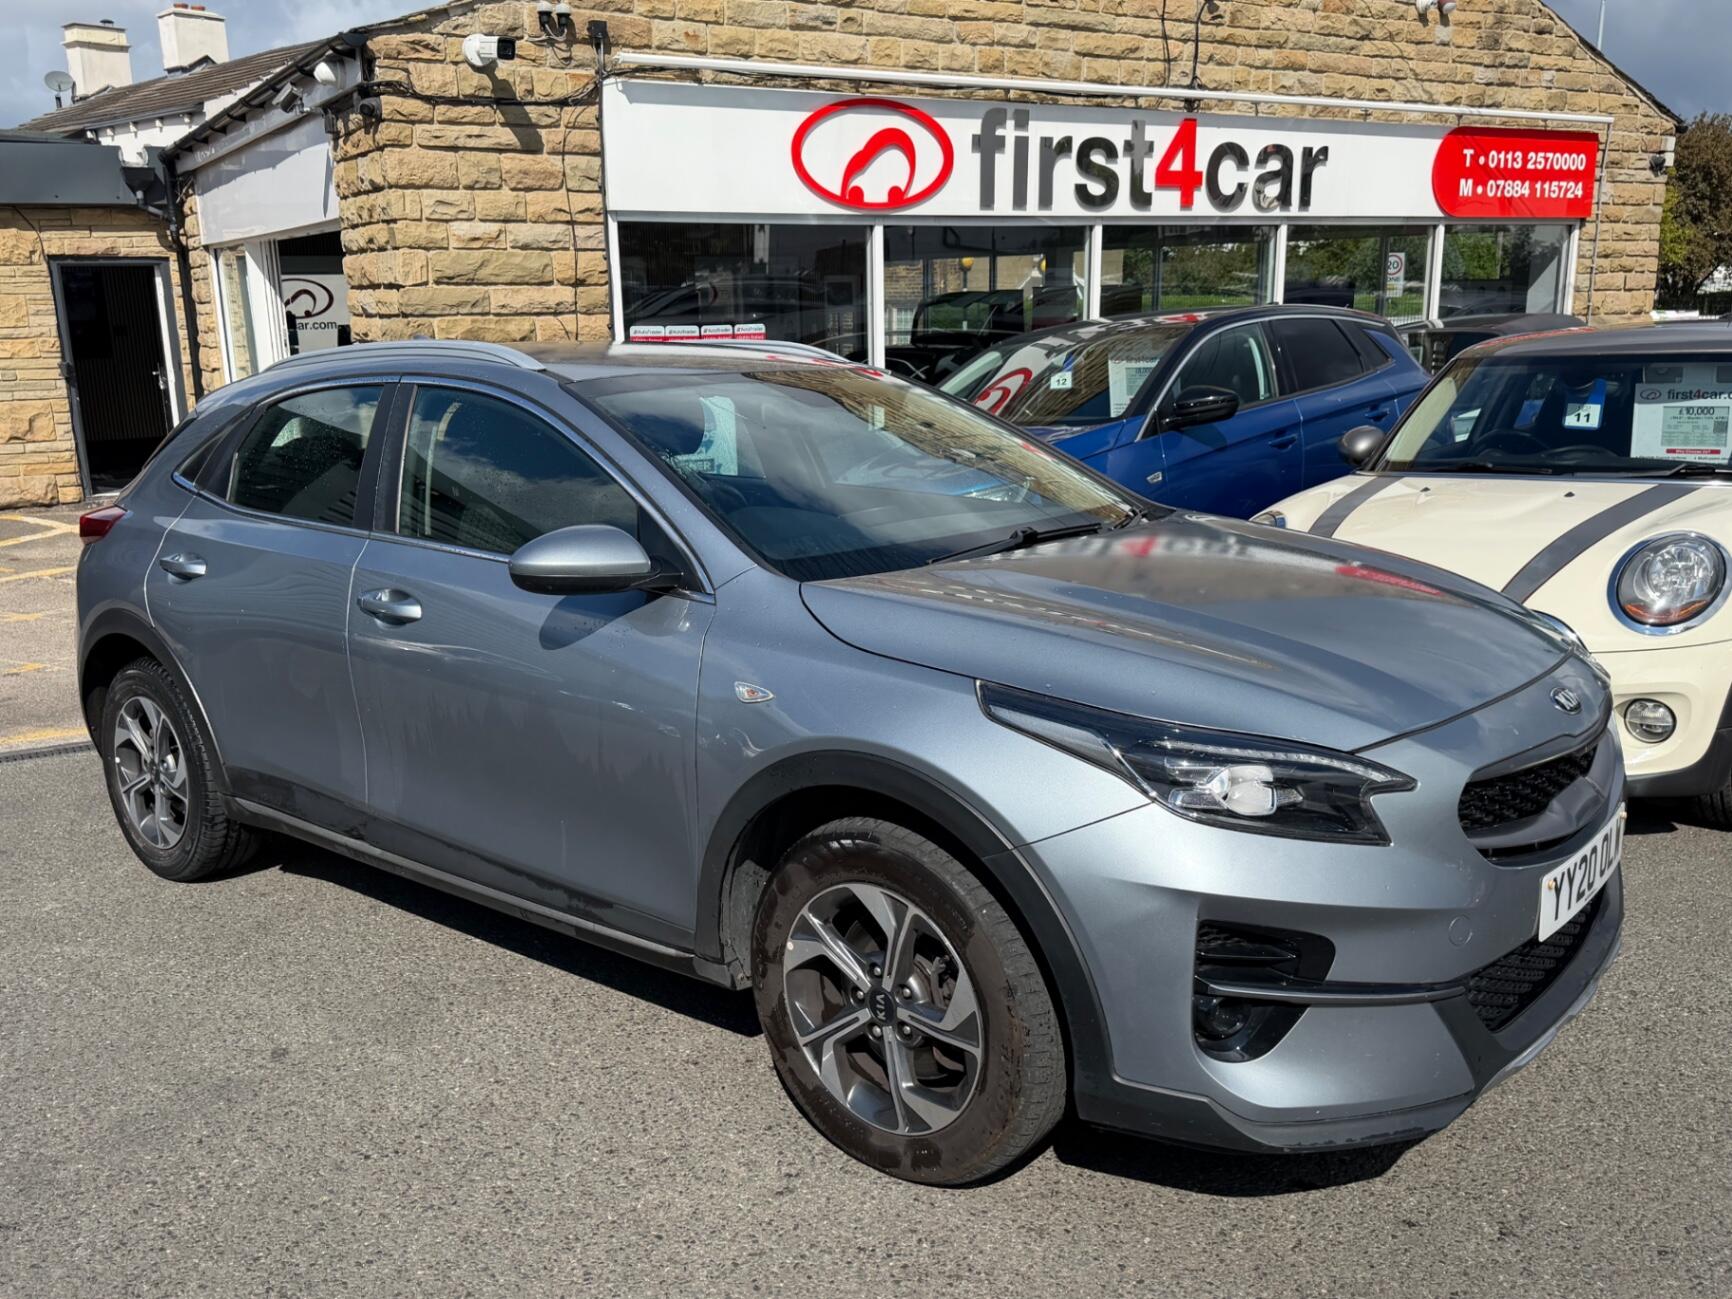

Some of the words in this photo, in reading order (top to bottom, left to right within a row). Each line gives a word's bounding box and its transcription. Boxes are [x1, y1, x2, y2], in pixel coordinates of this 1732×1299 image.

[971, 108, 1329, 212] first4car
[1463, 149, 1475, 167] T
[1488, 150, 1523, 168] 0113
[1527, 152, 1587, 171] 2570000
[1459, 178, 1473, 197] M
[1486, 179, 1530, 198] 07884
[1535, 180, 1583, 199] 115724
[296, 321, 337, 330] ar.com
[1056, 378, 1067, 386] 12
[1575, 412, 1591, 424] 11
[1679, 406, 1715, 416] £10,000
[1553, 845, 1598, 921] YY20
[876, 994, 886, 1020] KIA
